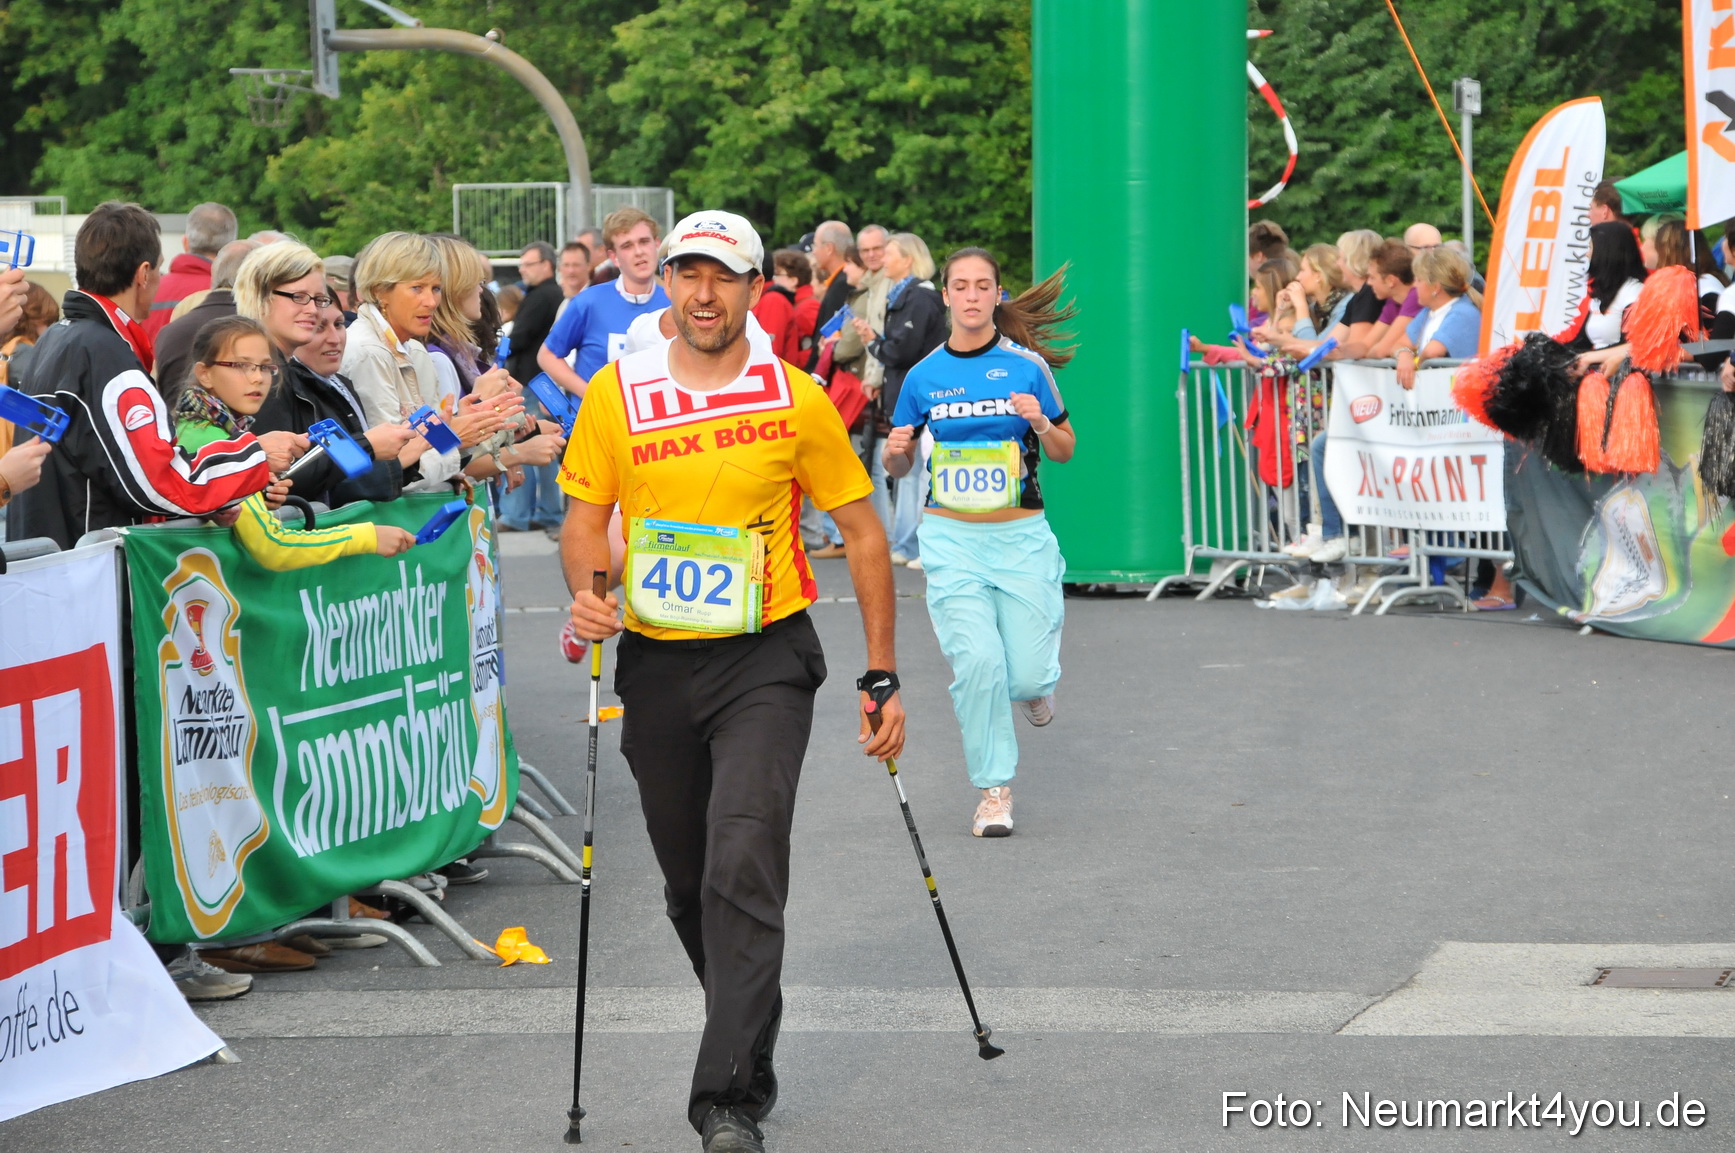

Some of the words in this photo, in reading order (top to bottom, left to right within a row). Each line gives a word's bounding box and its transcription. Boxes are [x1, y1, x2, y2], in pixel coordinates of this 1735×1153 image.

[1514, 146, 1570, 344] LEBL
[929, 387, 965, 399] TEAM
[1354, 401, 1379, 417] NEU!
[631, 434, 705, 466] MAX
[714, 419, 797, 449] BÖGL
[937, 467, 1006, 493] 1089
[648, 541, 690, 552] firmenlauf
[641, 556, 733, 606] 402
[299, 559, 447, 692] Neumarkter
[661, 601, 694, 614] Otmar
[266, 670, 471, 858] Lammsbräu
